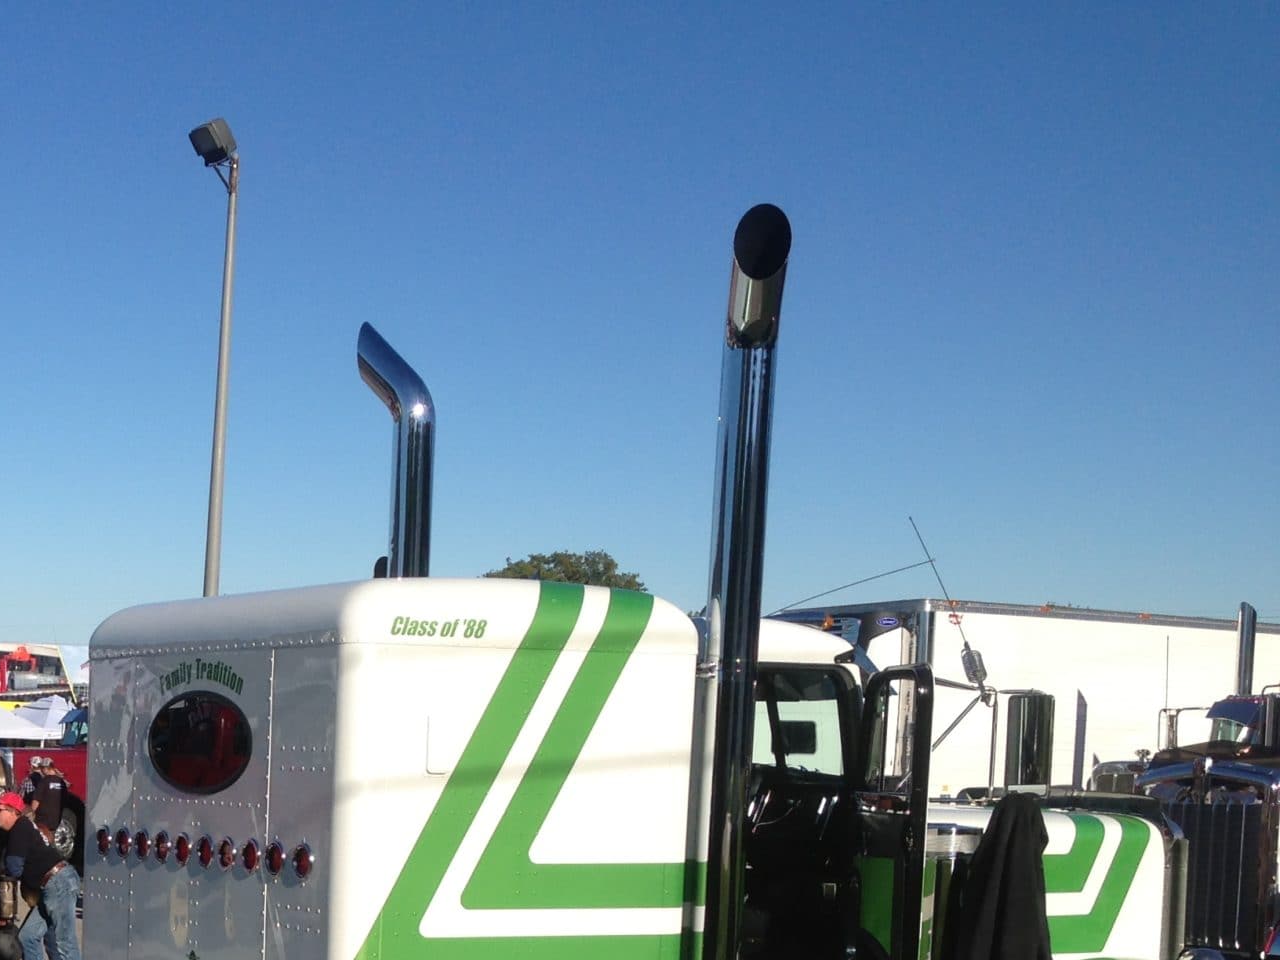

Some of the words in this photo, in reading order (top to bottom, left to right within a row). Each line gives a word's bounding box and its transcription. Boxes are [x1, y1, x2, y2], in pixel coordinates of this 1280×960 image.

[390, 616, 439, 637] Class
[440, 618, 460, 638] of
[463, 618, 488, 639] '88
[160, 661, 192, 696] Family
[195, 658, 244, 695] Tradition
